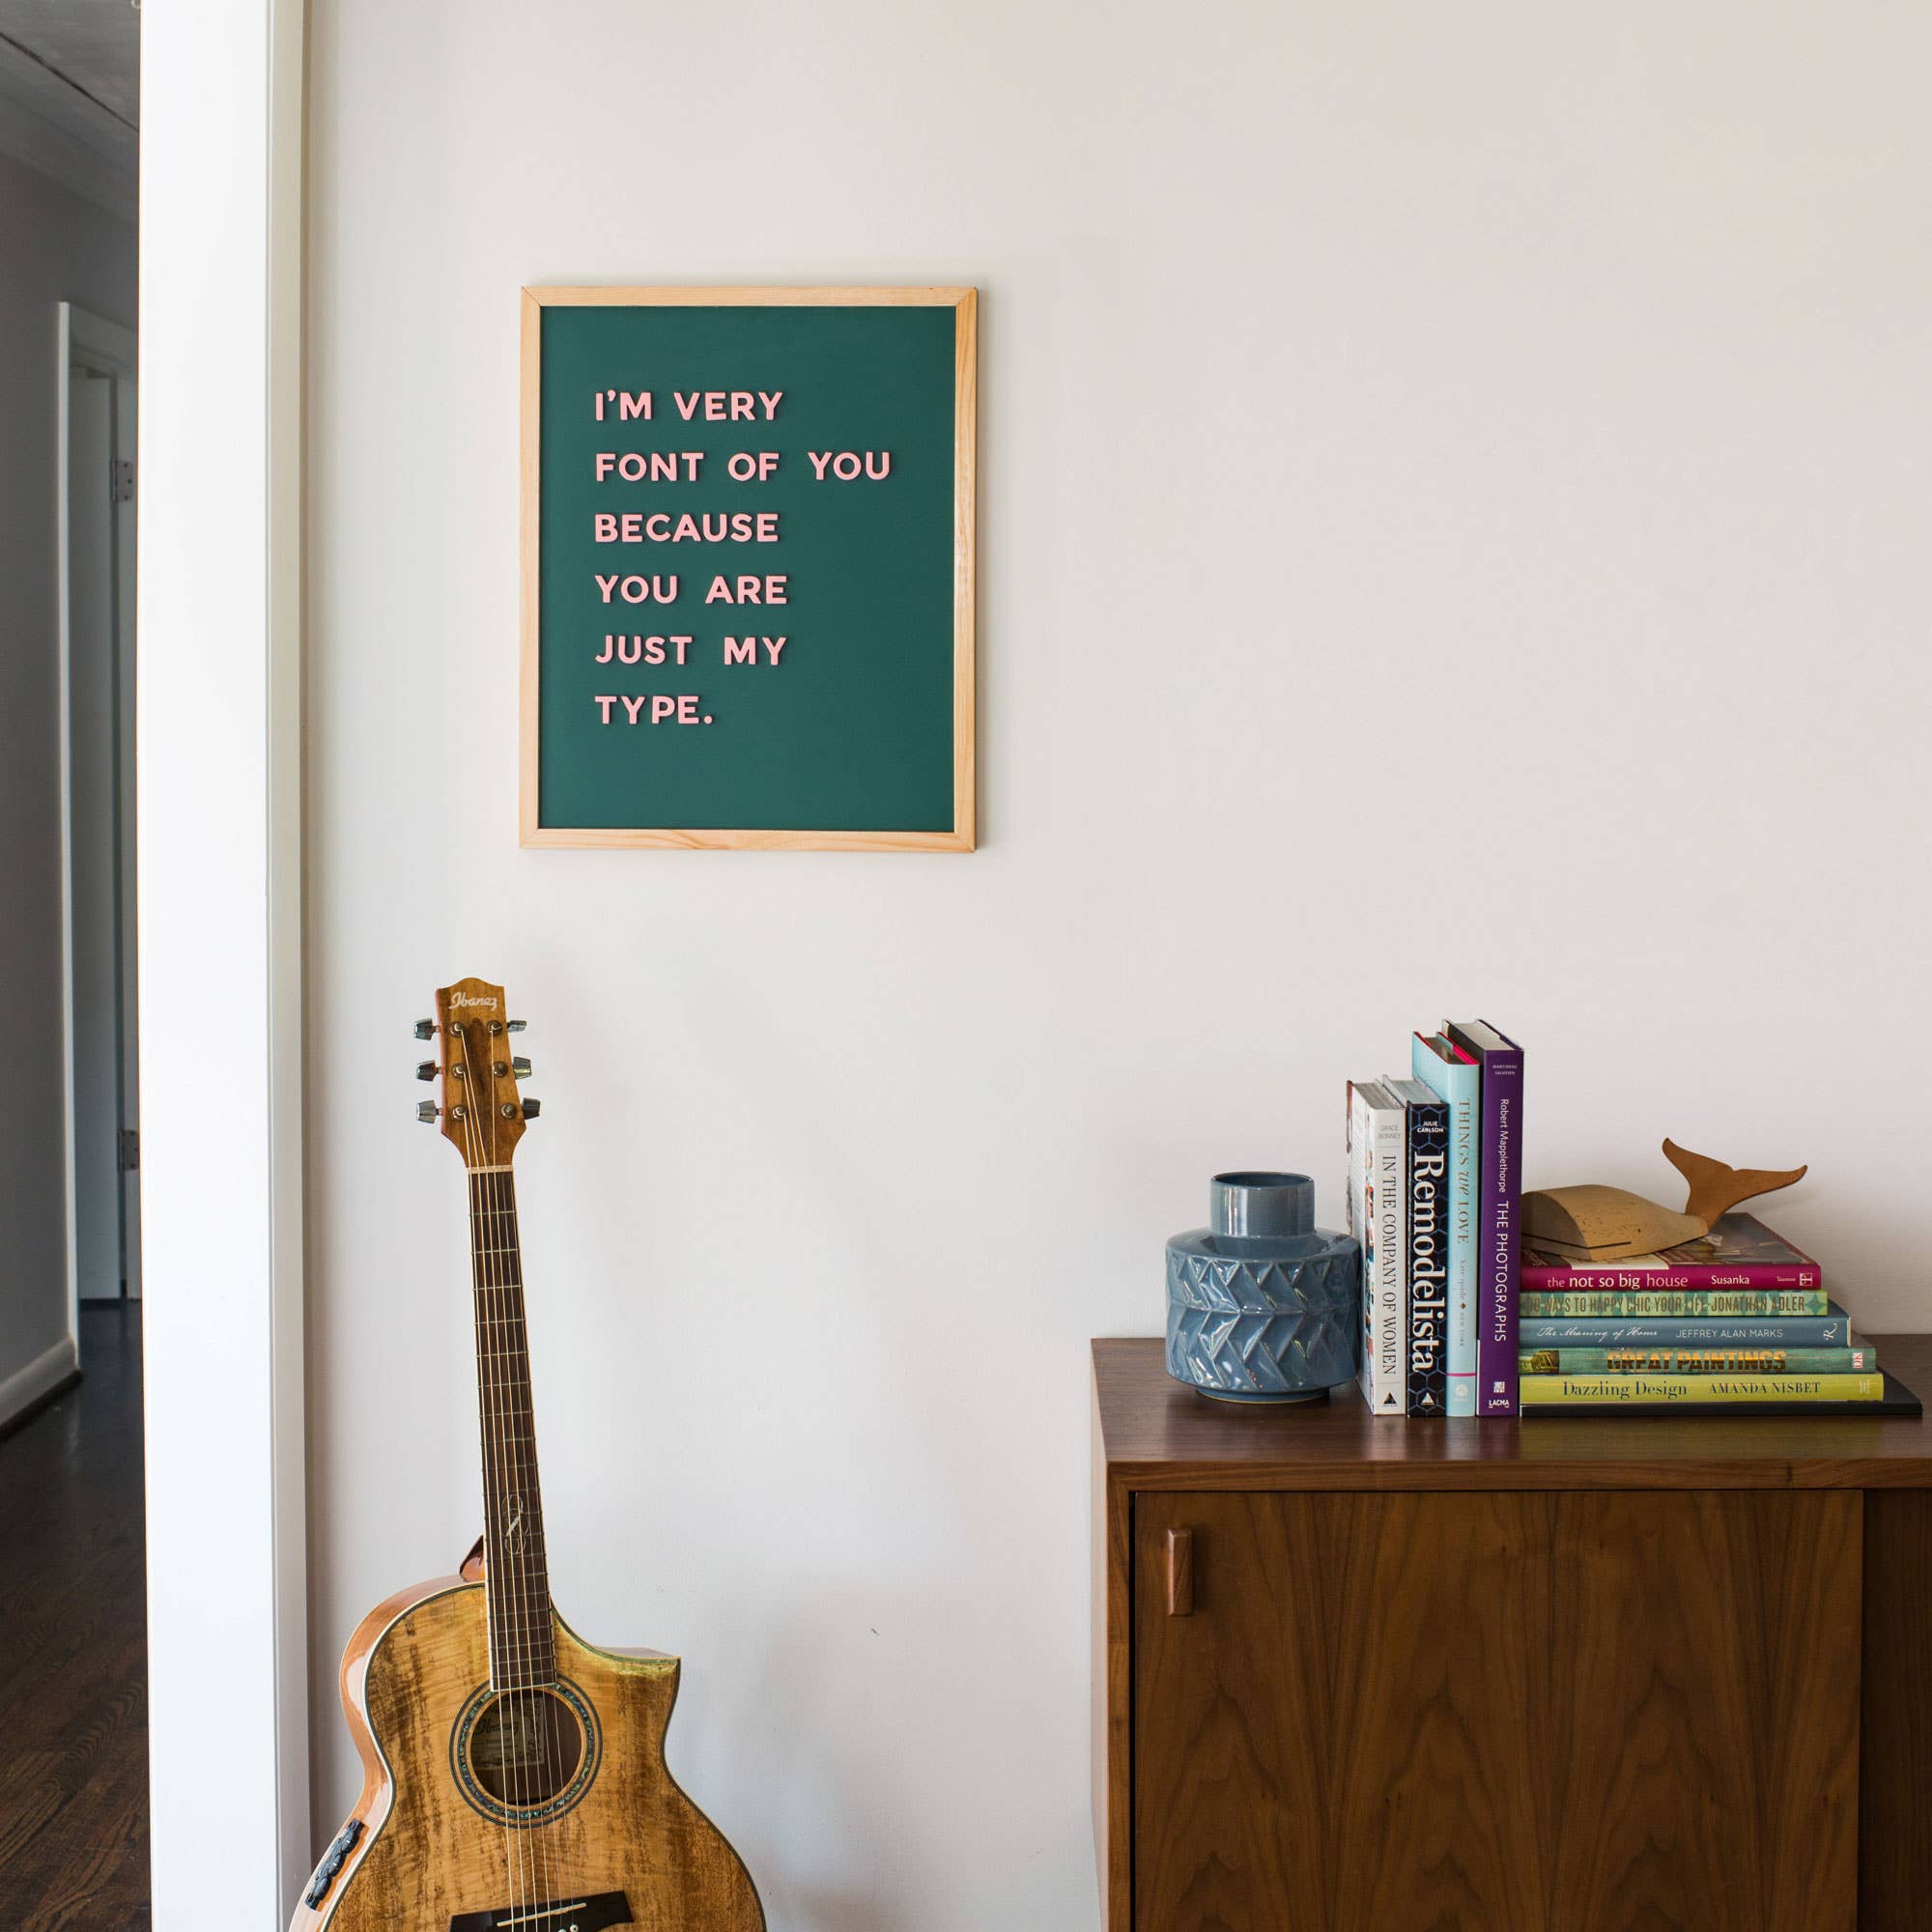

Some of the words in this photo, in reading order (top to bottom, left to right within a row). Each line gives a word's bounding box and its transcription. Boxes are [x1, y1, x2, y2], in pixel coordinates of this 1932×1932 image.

[595, 390, 652, 421] I'M
[673, 391, 783, 421] VERY
[595, 452, 704, 482] FONT
[727, 452, 780, 482] OF
[808, 451, 891, 481] YOU
[594, 513, 779, 543] BECAUSE
[594, 575, 678, 604] YOU
[704, 576, 787, 605] ARE
[594, 635, 693, 666] JUST
[724, 637, 787, 666] MY
[594, 696, 713, 724] TYPE.
[448, 991, 497, 1011] Ibanez
[1500, 1098, 1510, 1128] Robert
[1458, 1097, 1470, 1166] THINGS
[1382, 1155, 1397, 1172] IN
[1497, 1130, 1510, 1193] Mapplethorpe
[1382, 1177, 1397, 1208] THE
[1457, 1202, 1469, 1244] LOVE
[1496, 1199, 1509, 1229] THE
[1382, 1213, 1397, 1287] COMPANY
[1411, 1151, 1447, 1373] Remodelista
[1493, 1233, 1509, 1342] PHOTOGRAPHS
[1548, 1276, 1565, 1288] the
[1569, 1275, 1594, 1288] not
[1599, 1277, 1614, 1288] so
[1619, 1273, 1640, 1291] big
[1646, 1273, 1689, 1288] house
[1711, 1274, 1750, 1285] Susanka
[1382, 1292, 1397, 1312] OF
[1545, 1297, 1571, 1312] WAYS
[1574, 1297, 1586, 1312] TO
[1589, 1296, 1623, 1312] HAPPY
[1627, 1296, 1652, 1312] CHIC
[1655, 1296, 1685, 1312] YOUR
[1686, 1296, 1707, 1312] LIFE
[1711, 1296, 1767, 1312] JONATHAN
[1772, 1296, 1804, 1312] ADLER
[1382, 1316, 1397, 1375] WOMEN
[1537, 1326, 1556, 1337] The
[1559, 1326, 1608, 1342] Meaning
[1612, 1328, 1624, 1341] of
[1626, 1326, 1658, 1337] Home
[1676, 1329, 1719, 1338] JEFFREY
[1720, 1329, 1747, 1338] ALAN
[1749, 1329, 1784, 1338] MARKS
[1606, 1350, 1673, 1372] GREAT
[1676, 1350, 1786, 1372] PAINTINGS
[1853, 1352, 1862, 1368] DK
[1489, 1399, 1509, 1407] LACMA
[1563, 1380, 1631, 1400] Dazzling
[1636, 1380, 1688, 1400] Design
[1709, 1382, 1768, 1394] AMANDA
[1772, 1381, 1821, 1394] NISBET
